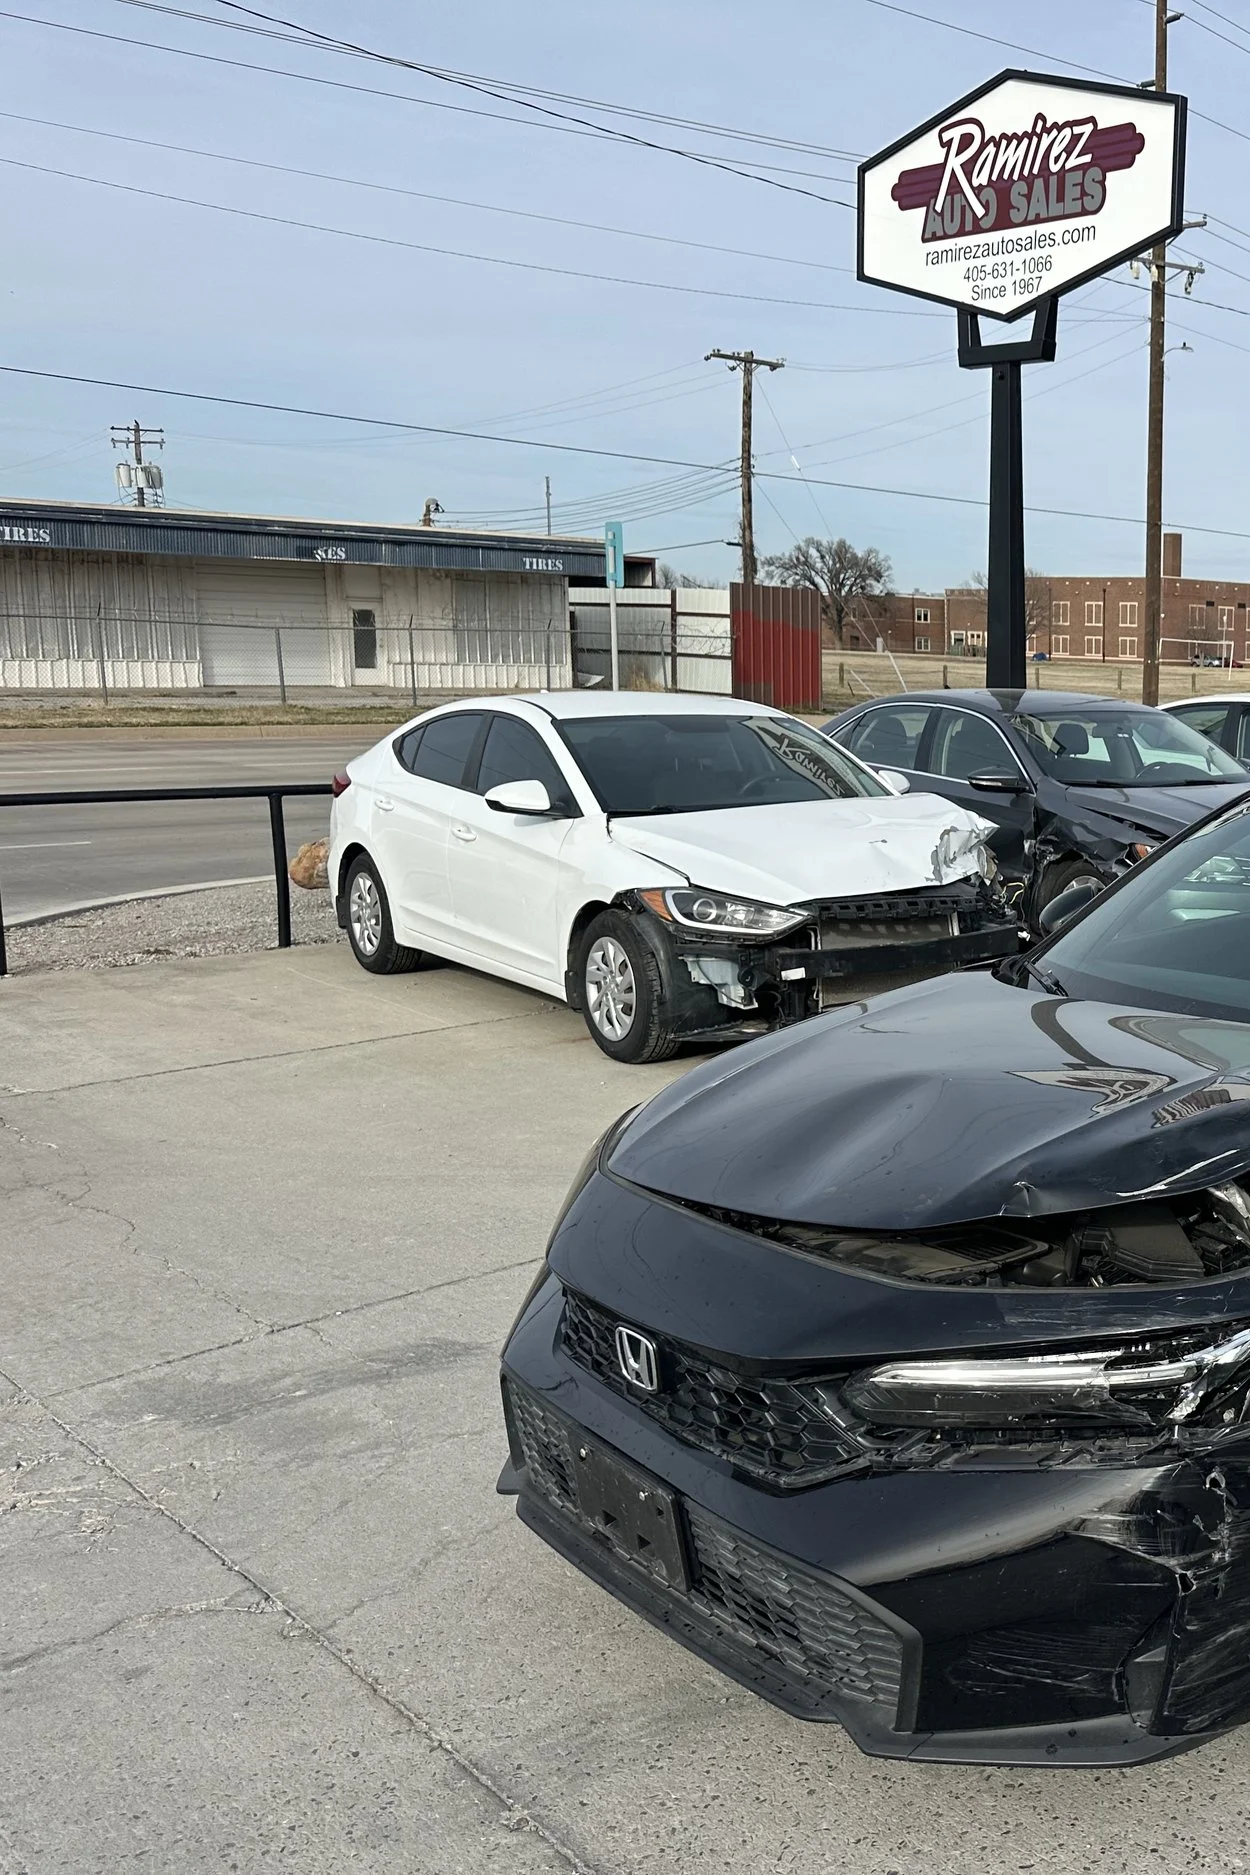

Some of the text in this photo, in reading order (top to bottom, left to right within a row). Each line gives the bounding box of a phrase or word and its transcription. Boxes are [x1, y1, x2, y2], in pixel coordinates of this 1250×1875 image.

[935, 117, 1095, 219] Ramirez
[923, 166, 1103, 239] AUTO SALES
[925, 225, 1096, 266] ramirezautosales.com
[963, 255, 1053, 283] 405-631-1066
[971, 277, 1043, 301] Since 1967
[0, 526, 50, 543] IRES
[523, 557, 563, 571] TIRES
